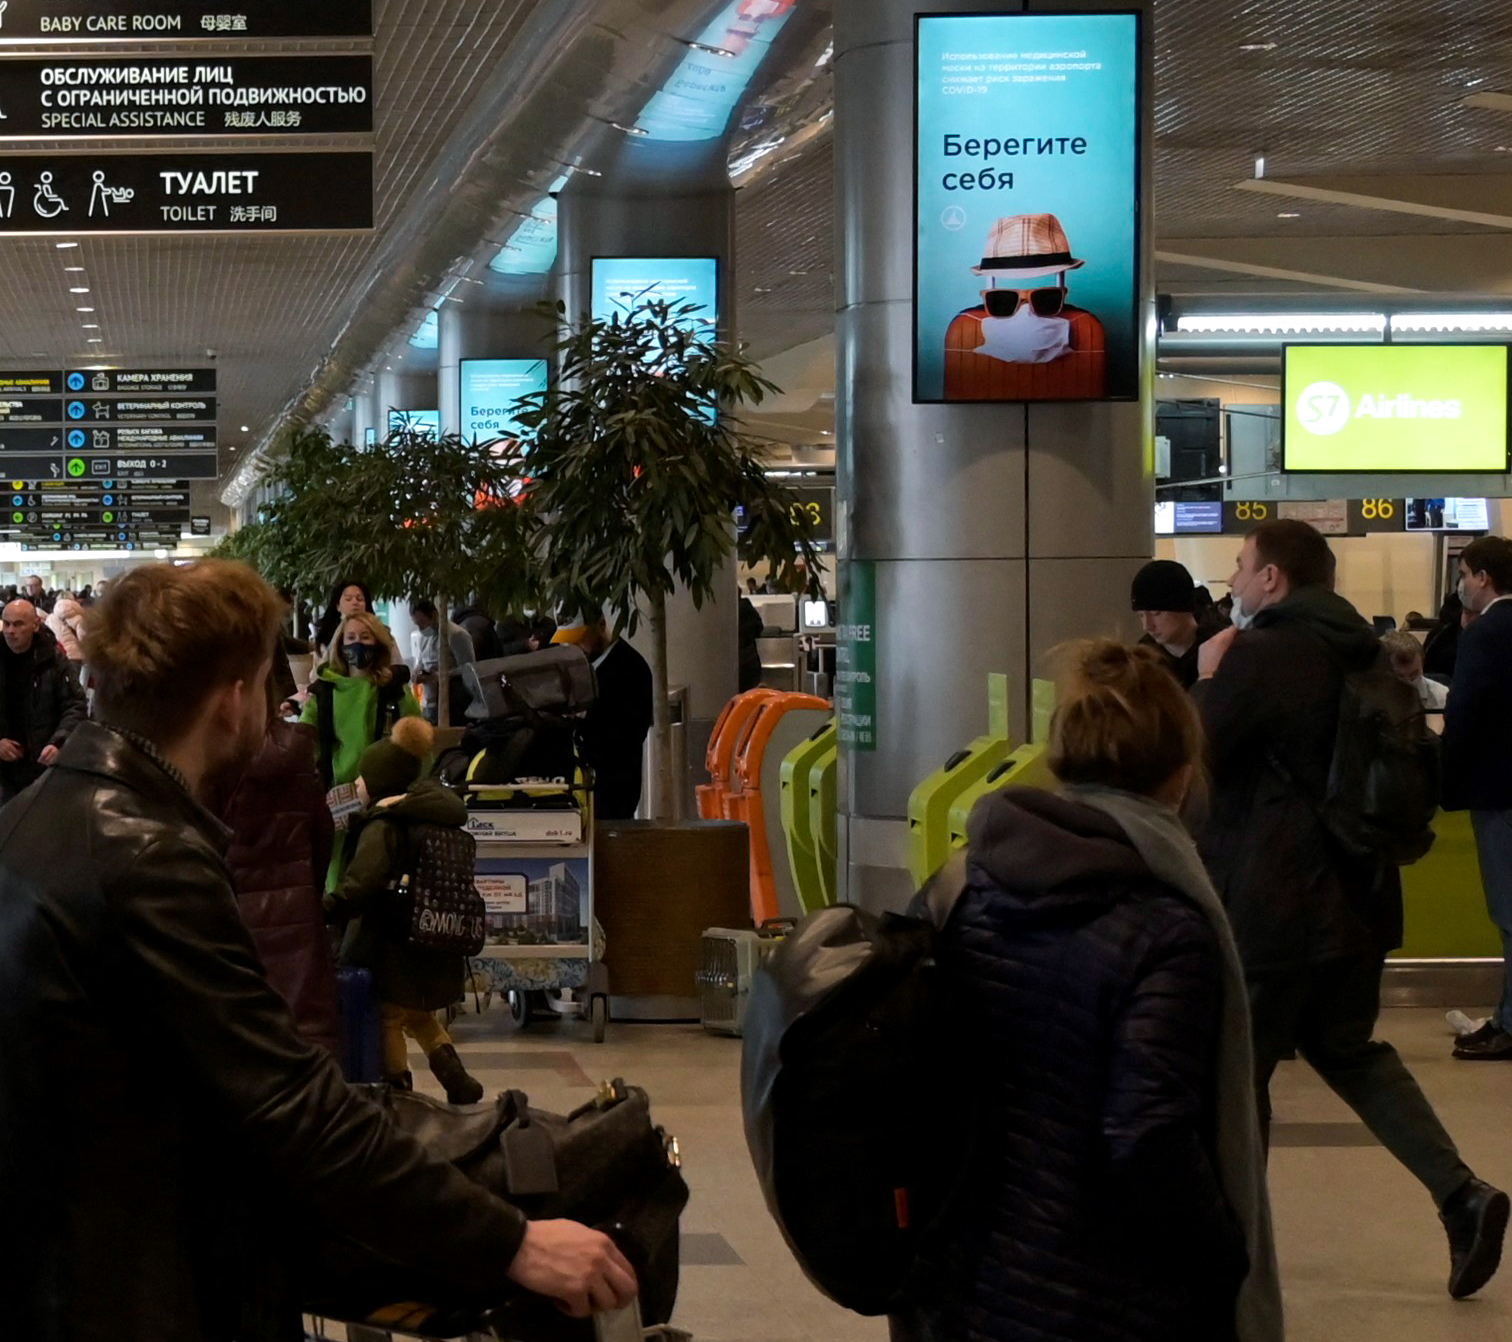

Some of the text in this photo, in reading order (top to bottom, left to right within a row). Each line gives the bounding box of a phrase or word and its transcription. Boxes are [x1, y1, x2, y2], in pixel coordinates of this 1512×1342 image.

[41, 15, 247, 31] BABY CARE ROOM 母婴室
[41, 67, 233, 85] ОБСЛУЖИВАНИЕ ЛИЦ
[41, 85, 365, 108] С ОГРАНИЧЕННОЙ ПОДВИЖНОСТЬЮ
[41, 112, 105, 128] SPECIAL
[110, 111, 205, 127] ASSISTANCE
[943, 134, 1087, 160] Берегите
[160, 172, 259, 194] ТУАЛЕТ
[943, 167, 1013, 190] себя
[160, 206, 277, 222] TOILET 洗手间
[117, 374, 192, 382] КАМЕРА ХРАНЕНИЯ
[1355, 394, 1461, 419] Airlines
[471, 420, 499, 429] себя
